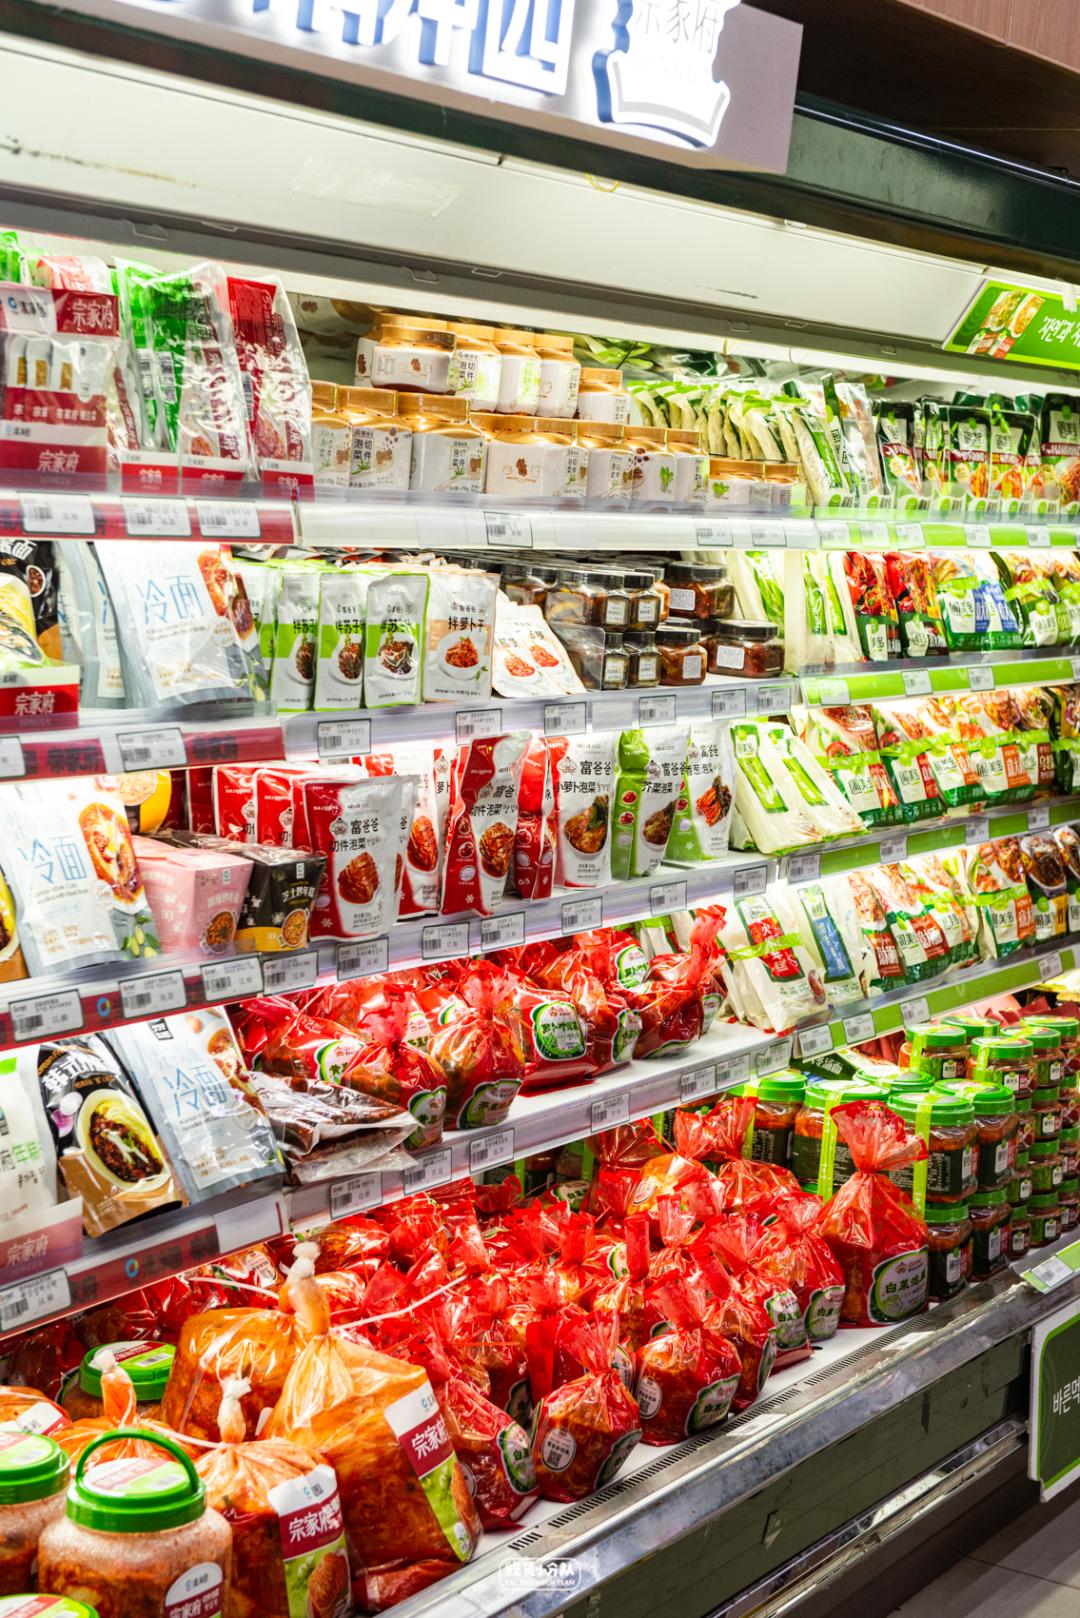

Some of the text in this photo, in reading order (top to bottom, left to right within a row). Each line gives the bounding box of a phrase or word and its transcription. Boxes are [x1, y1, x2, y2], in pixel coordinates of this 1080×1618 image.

[72, 298, 114, 330] 宗家府
[135, 575, 205, 625] 冷面
[448, 615, 485, 633] 拌萝卜干
[15, 690, 56, 717] 宗家府
[580, 760, 611, 776] 富爸爸
[350, 817, 379, 835] 富爸爸
[18, 836, 87, 884] 冷面
[329, 837, 367, 853] 切件泡菜
[161, 1064, 228, 1117] 冷面
[7, 1234, 49, 1266] 宗家府
[411, 1415, 447, 1460] 宗家府
[289, 1509, 329, 1543] 宗家府
